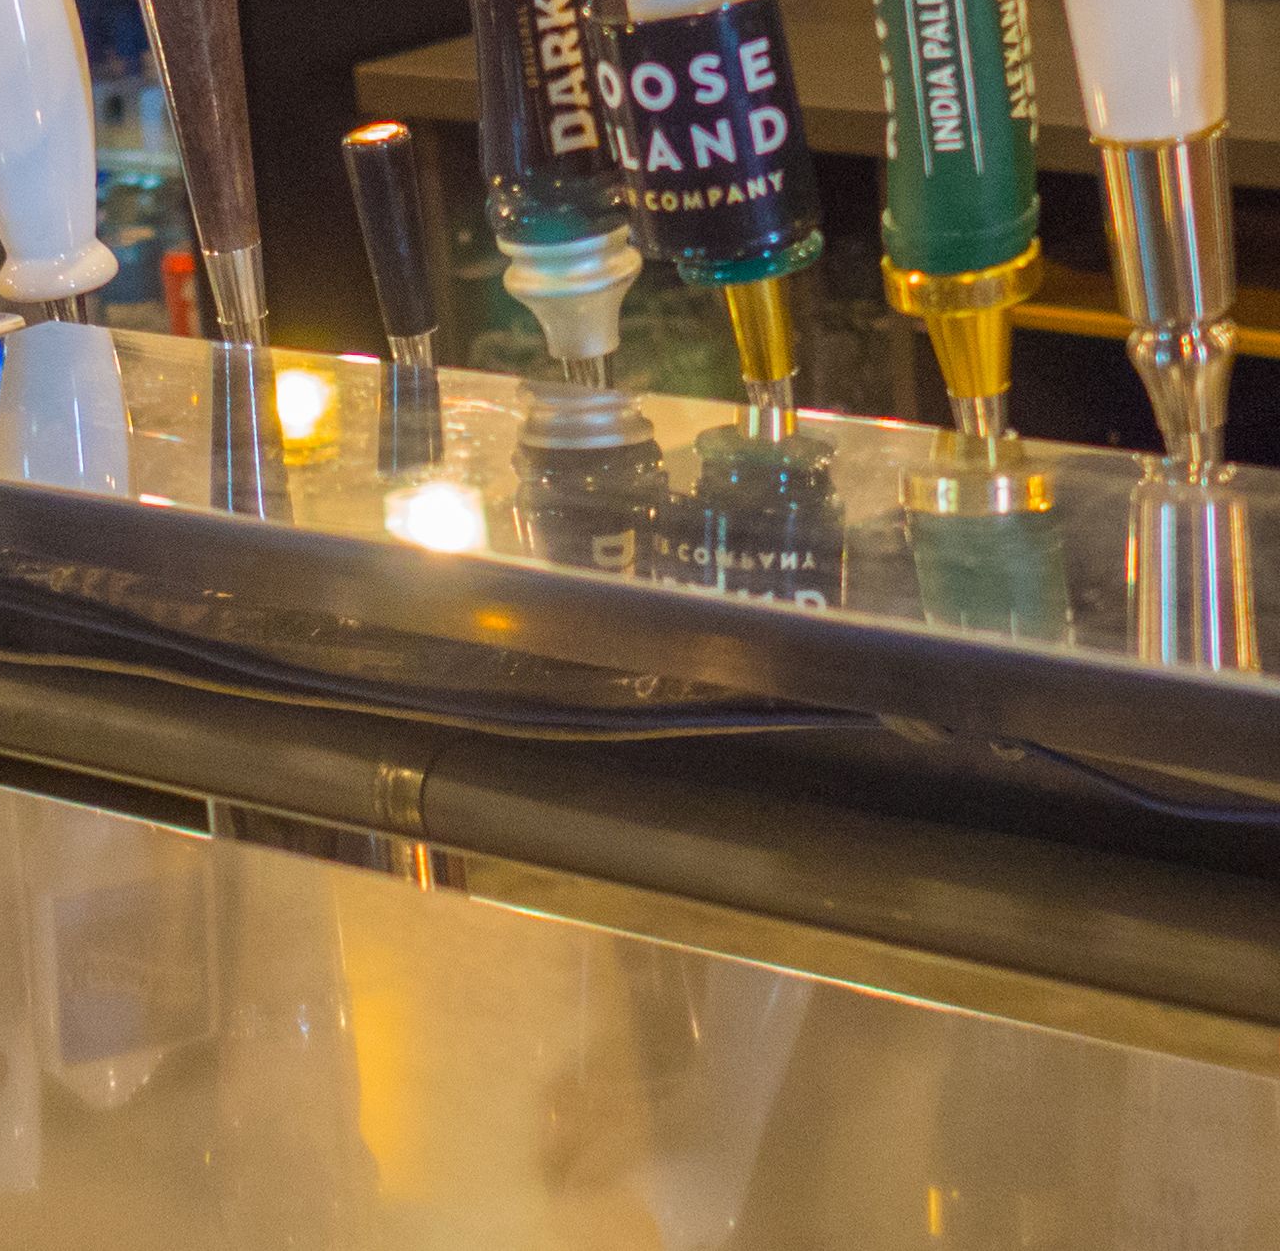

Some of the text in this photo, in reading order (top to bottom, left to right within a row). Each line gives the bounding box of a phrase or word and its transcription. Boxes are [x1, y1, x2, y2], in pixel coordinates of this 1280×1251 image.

[595, 35, 777, 112] OOSE
[926, 63, 966, 153] INDIA
[605, 105, 788, 173] LAND
[643, 169, 785, 212] COMPANY
